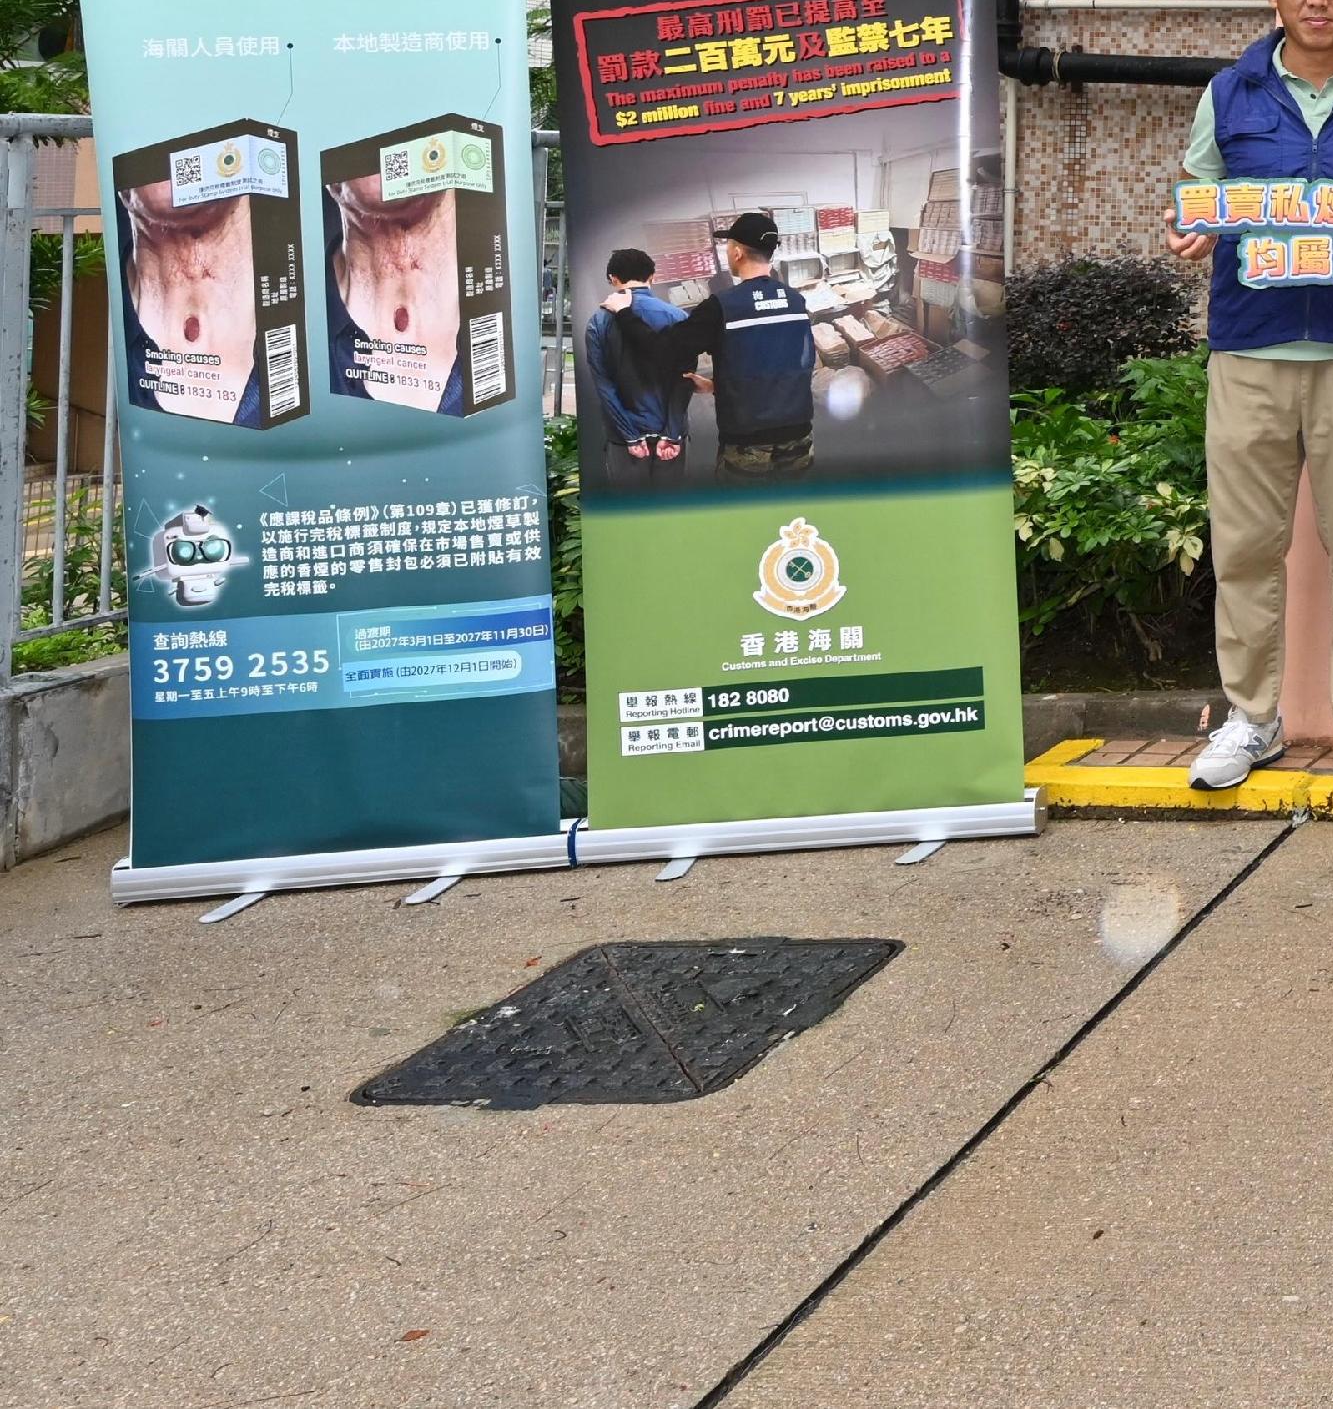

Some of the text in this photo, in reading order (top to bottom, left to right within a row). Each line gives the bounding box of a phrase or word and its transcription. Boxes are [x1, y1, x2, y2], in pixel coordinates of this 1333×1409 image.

[142, 36, 280, 58] 海關人員使用
[333, 31, 490, 53] 本地製造商使用
[597, 15, 954, 84] 罰款二百萬元及監禁七年
[605, 91, 636, 107] The
[640, 83, 724, 103] maximum
[824, 64, 863, 80] been
[866, 56, 916, 74] raised
[920, 53, 936, 67] to
[615, 110, 637, 128] $2
[641, 104, 699, 124] million
[741, 94, 772, 110] and
[774, 91, 783, 106] 7
[841, 69, 952, 96] imprisonment
[145, 348, 221, 365] Smoking causes
[354, 338, 426, 356] Smoking causes
[154, 630, 228, 650] 查詢熱線
[740, 626, 864, 657] 香港海關
[153, 650, 329, 683] 3759 2535
[721, 659, 766, 672] Customs
[707, 687, 790, 709] 182 8080
[708, 706, 978, 742] crimereport@customs.gov.hk
